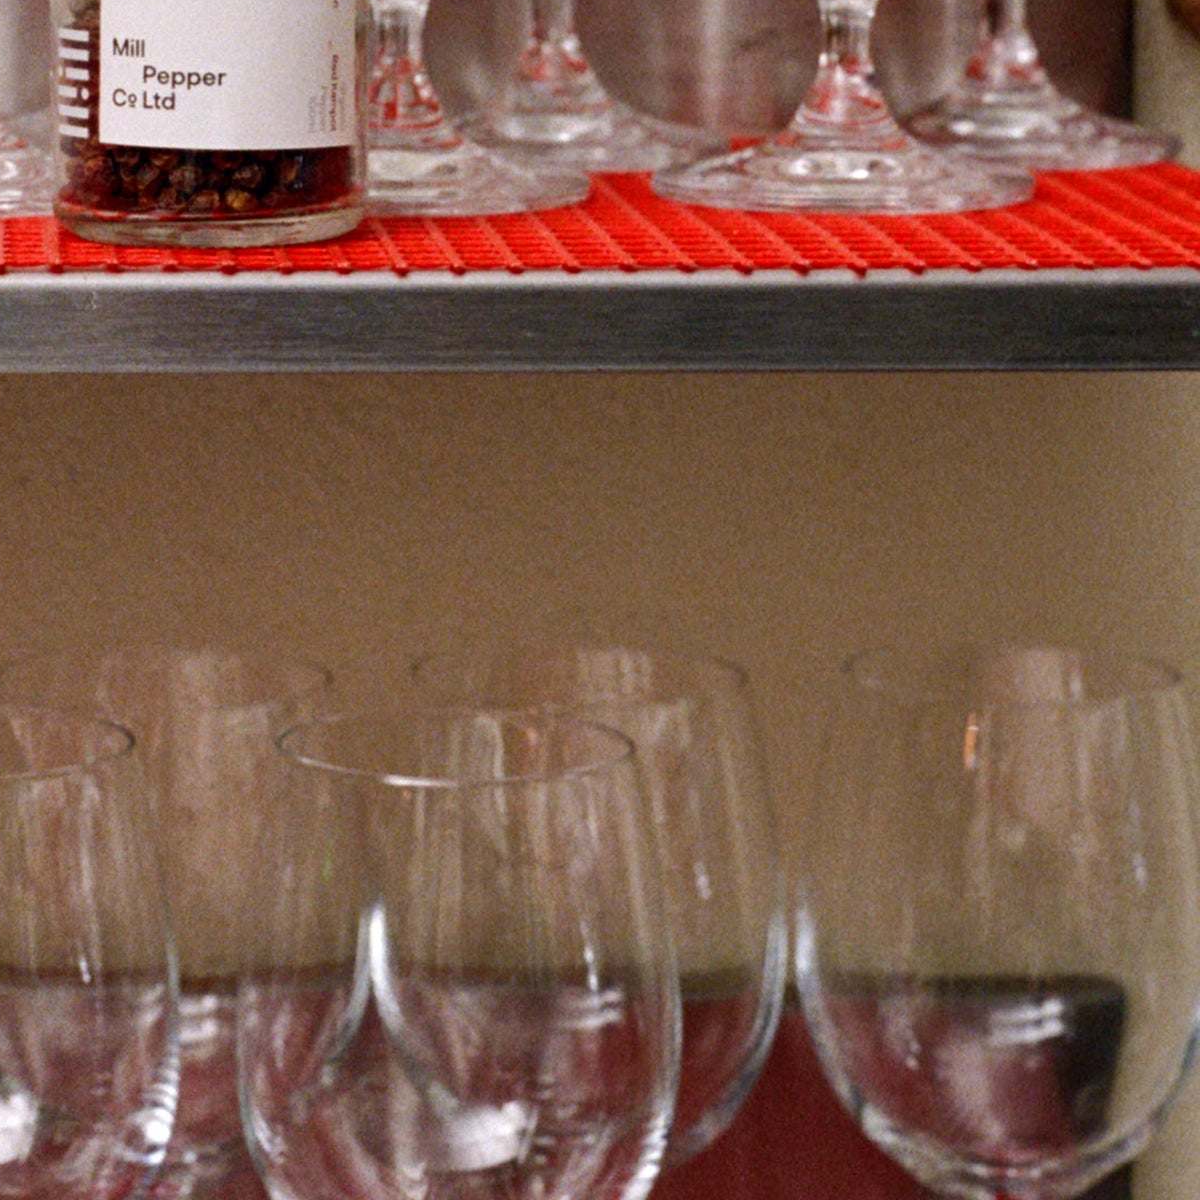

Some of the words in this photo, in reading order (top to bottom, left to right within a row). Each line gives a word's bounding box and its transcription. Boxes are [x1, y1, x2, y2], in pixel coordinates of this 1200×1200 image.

[112, 37, 146, 58] Mill
[143, 65, 227, 90] Pepper
[331, 54, 339, 81] Red
[143, 91, 176, 110] Ltd
